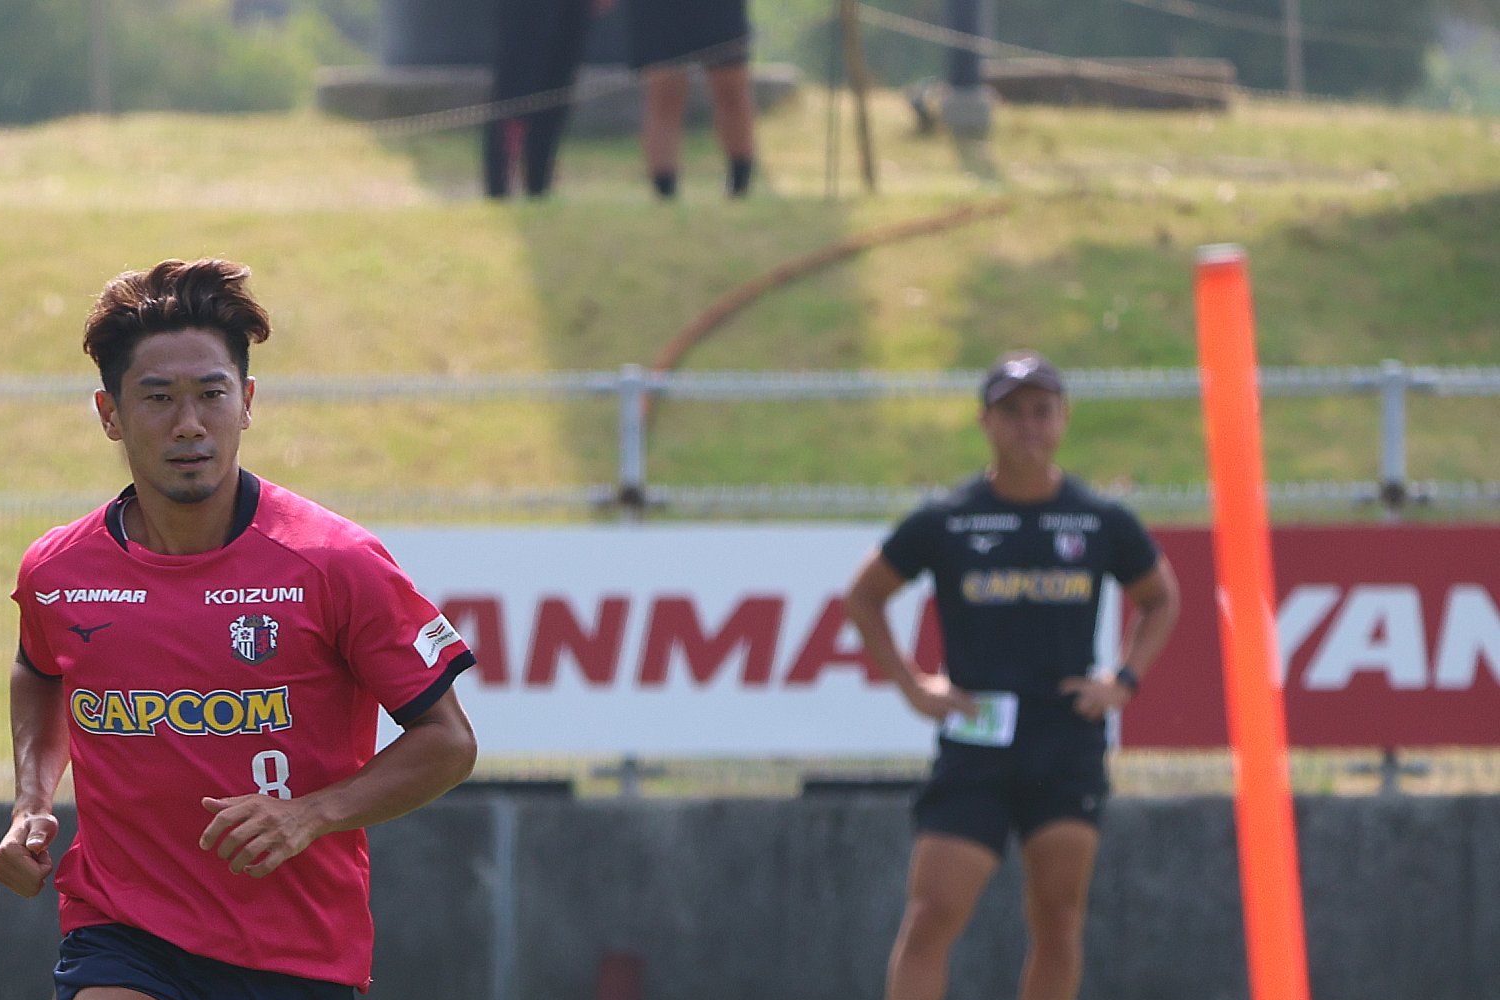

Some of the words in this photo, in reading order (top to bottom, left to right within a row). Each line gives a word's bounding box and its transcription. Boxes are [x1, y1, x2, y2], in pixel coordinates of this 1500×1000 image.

[63, 589, 148, 603] YANMAR
[204, 587, 304, 605] KOIZUMI
[71, 686, 293, 736] CAPCOM
[252, 750, 293, 801] 8
